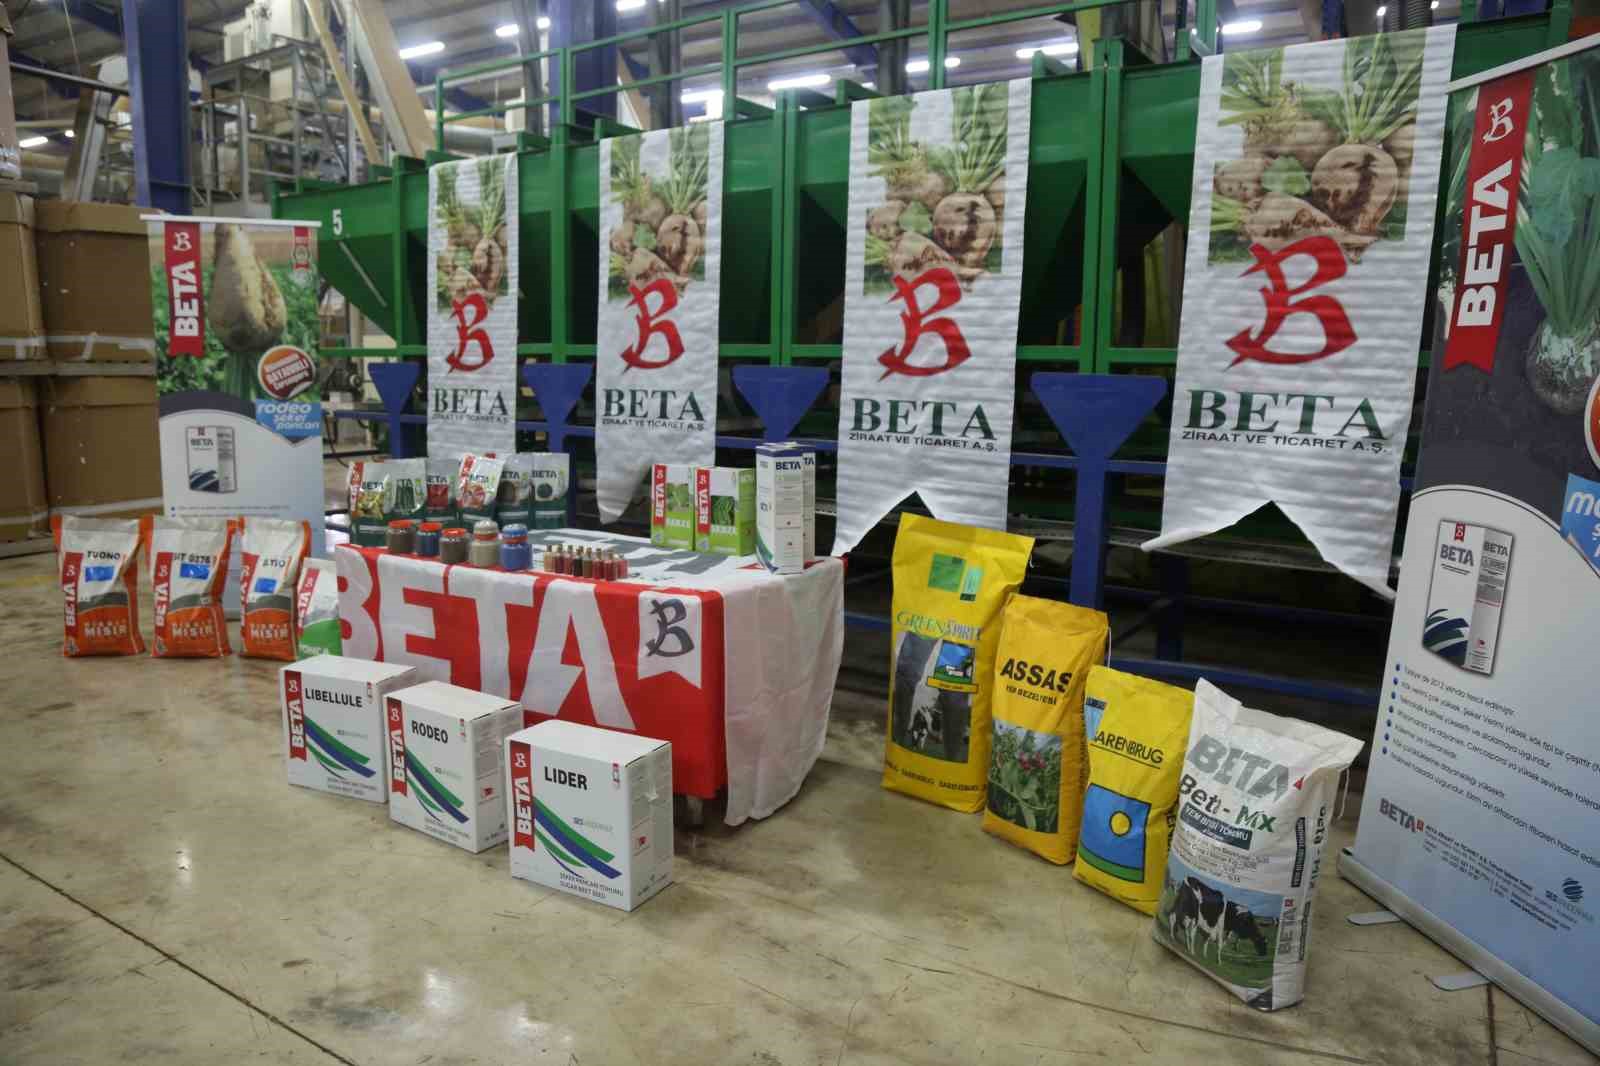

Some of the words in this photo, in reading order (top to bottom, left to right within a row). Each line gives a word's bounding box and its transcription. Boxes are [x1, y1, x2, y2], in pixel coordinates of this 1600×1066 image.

[332, 208, 343, 236] 5
[1457, 158, 1514, 328] BETA
[172, 260, 199, 337] BETA
[257, 402, 312, 414] rodeo
[434, 388, 508, 415] BETA
[603, 388, 705, 421] BETA
[1186, 389, 1389, 441] BETA
[850, 397, 997, 441] BETA
[848, 431, 891, 444] ZİRAAT
[895, 435, 911, 445] VE
[913, 434, 968, 450] TİCARET
[1182, 429, 1240, 444] ZİRAAT
[1245, 434, 1268, 445] VE
[1273, 434, 1346, 452] TİCARET
[531, 470, 557, 479] BETA
[775, 461, 801, 471] BETA
[698, 490, 709, 525] BETA
[1440, 543, 1474, 566] BETA
[1484, 542, 1508, 556] BETA
[64, 582, 77, 627] BETA
[154, 582, 169, 627] BETA
[1000, 658, 1072, 693] ASSAS
[305, 687, 363, 710] LIBELLULE
[290, 698, 305, 748] BETA
[411, 719, 449, 744] RODEO
[391, 730, 406, 782] BETA
[1187, 734, 1289, 803] BETA
[544, 765, 588, 791] LIDER
[516, 781, 534, 835] BETA
[1379, 797, 1416, 833] BETA
